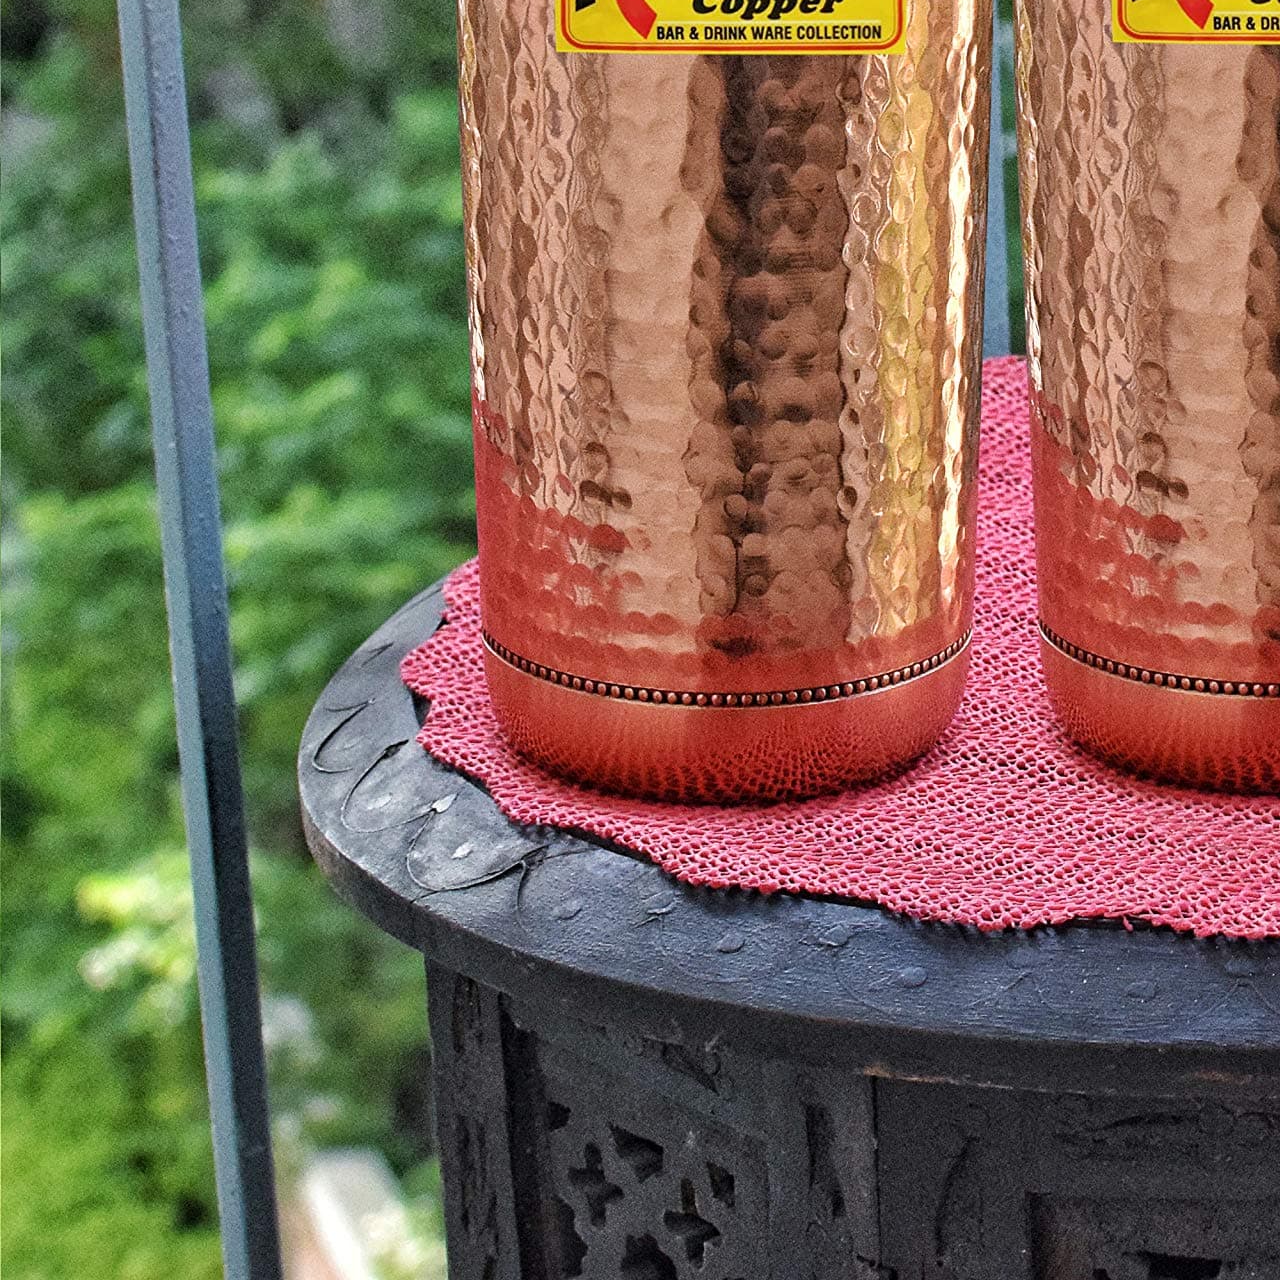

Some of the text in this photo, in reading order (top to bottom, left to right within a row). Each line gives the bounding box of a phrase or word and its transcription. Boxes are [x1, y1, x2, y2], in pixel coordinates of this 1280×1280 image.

[1213, 15, 1241, 31] BAR
[1245, 16, 1256, 31] &
[656, 25, 882, 41] BAR & DRINK WARE COLLECTION
